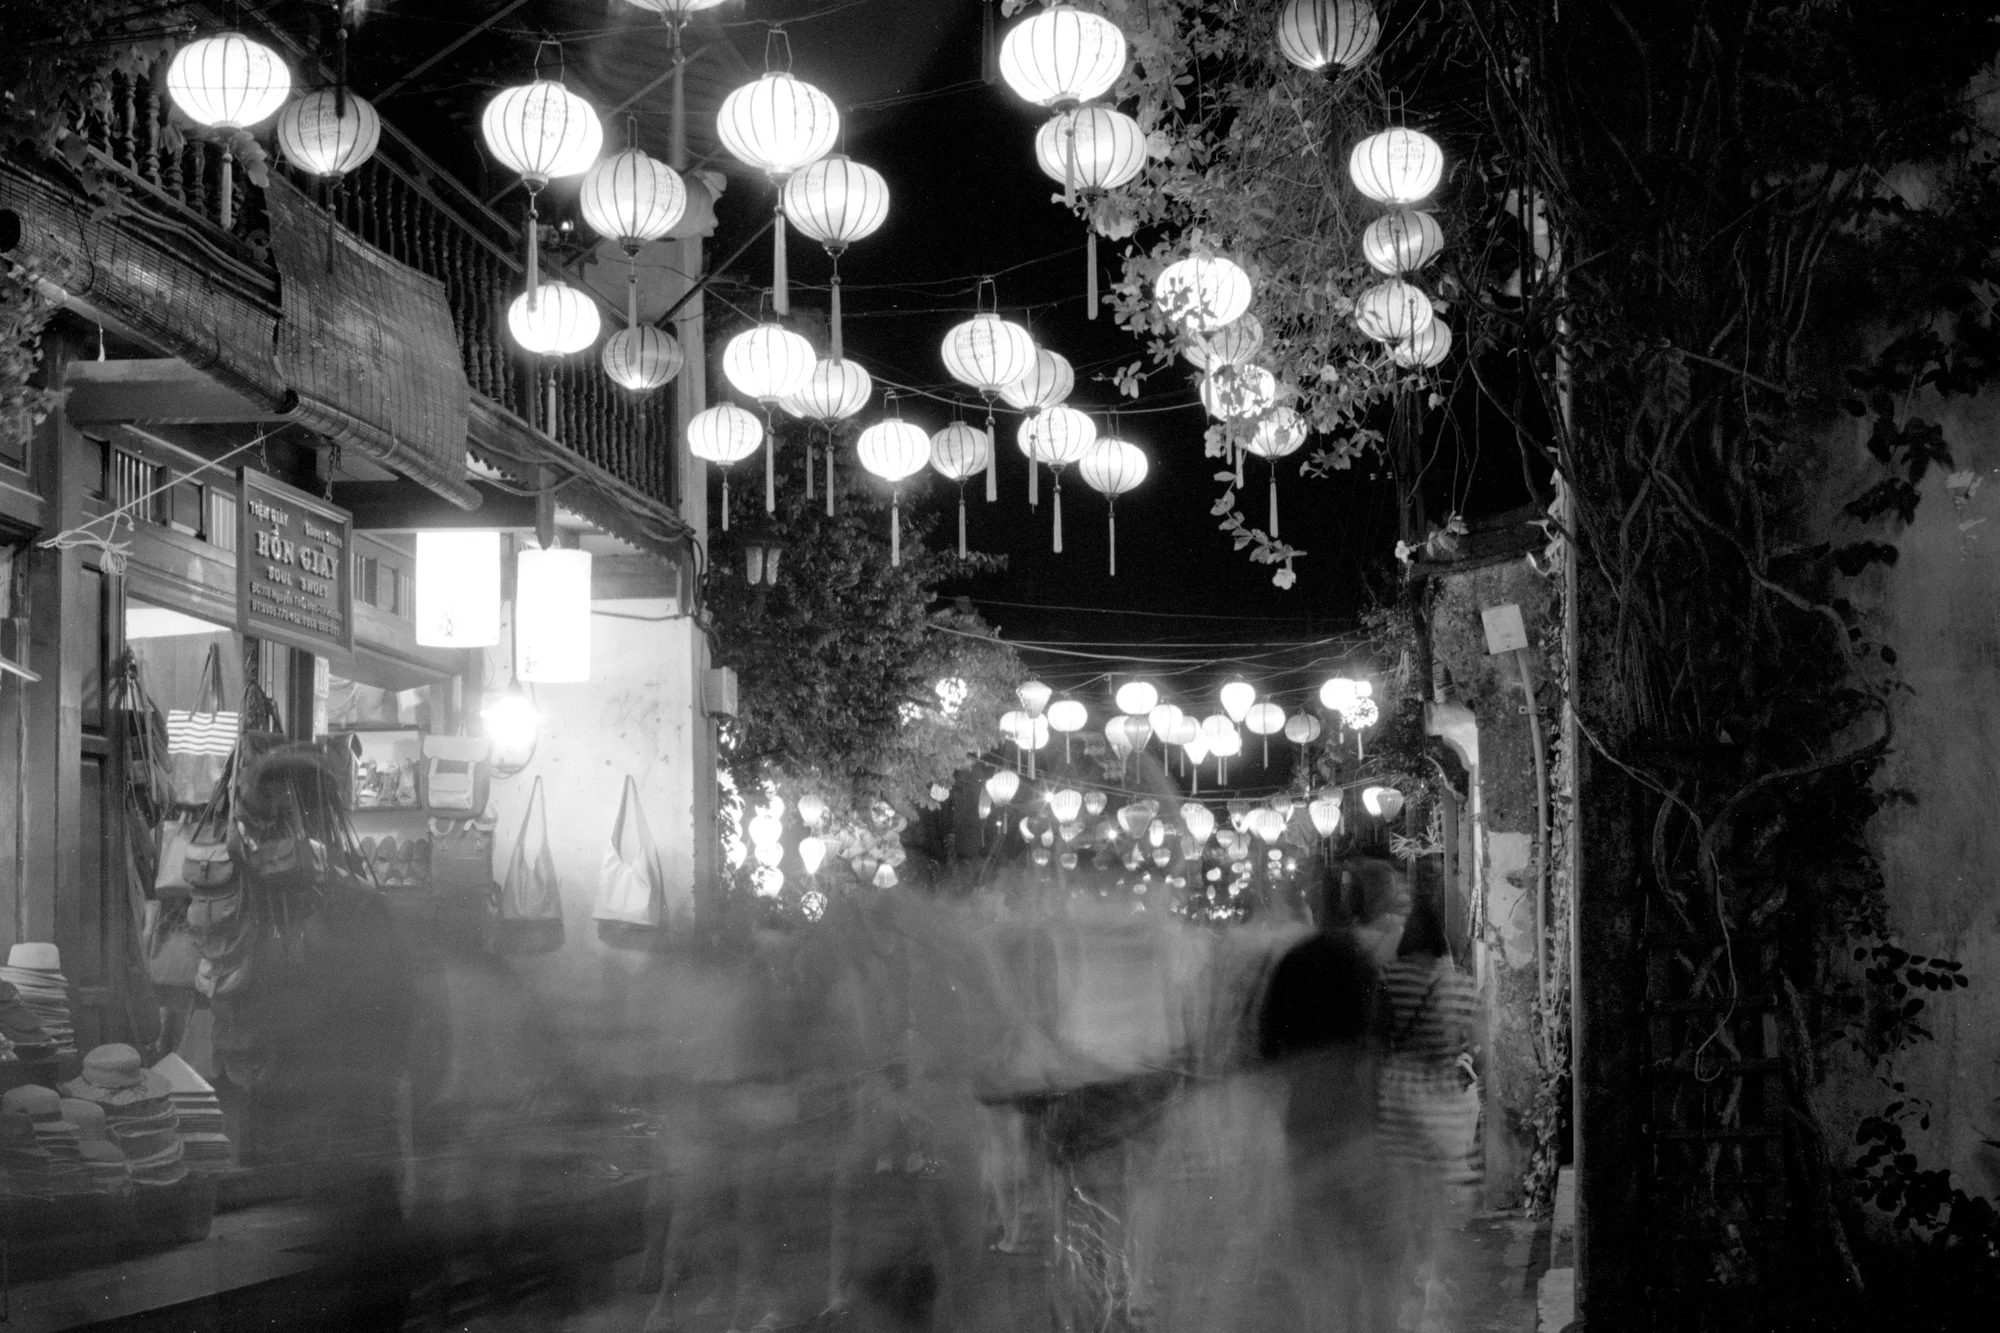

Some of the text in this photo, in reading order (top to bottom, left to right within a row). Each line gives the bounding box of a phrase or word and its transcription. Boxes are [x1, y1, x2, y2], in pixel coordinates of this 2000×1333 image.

[299, 117, 341, 129] ROATER
[957, 339, 996, 350] ROATERY
[268, 565, 328, 598] SOUL SHOES
